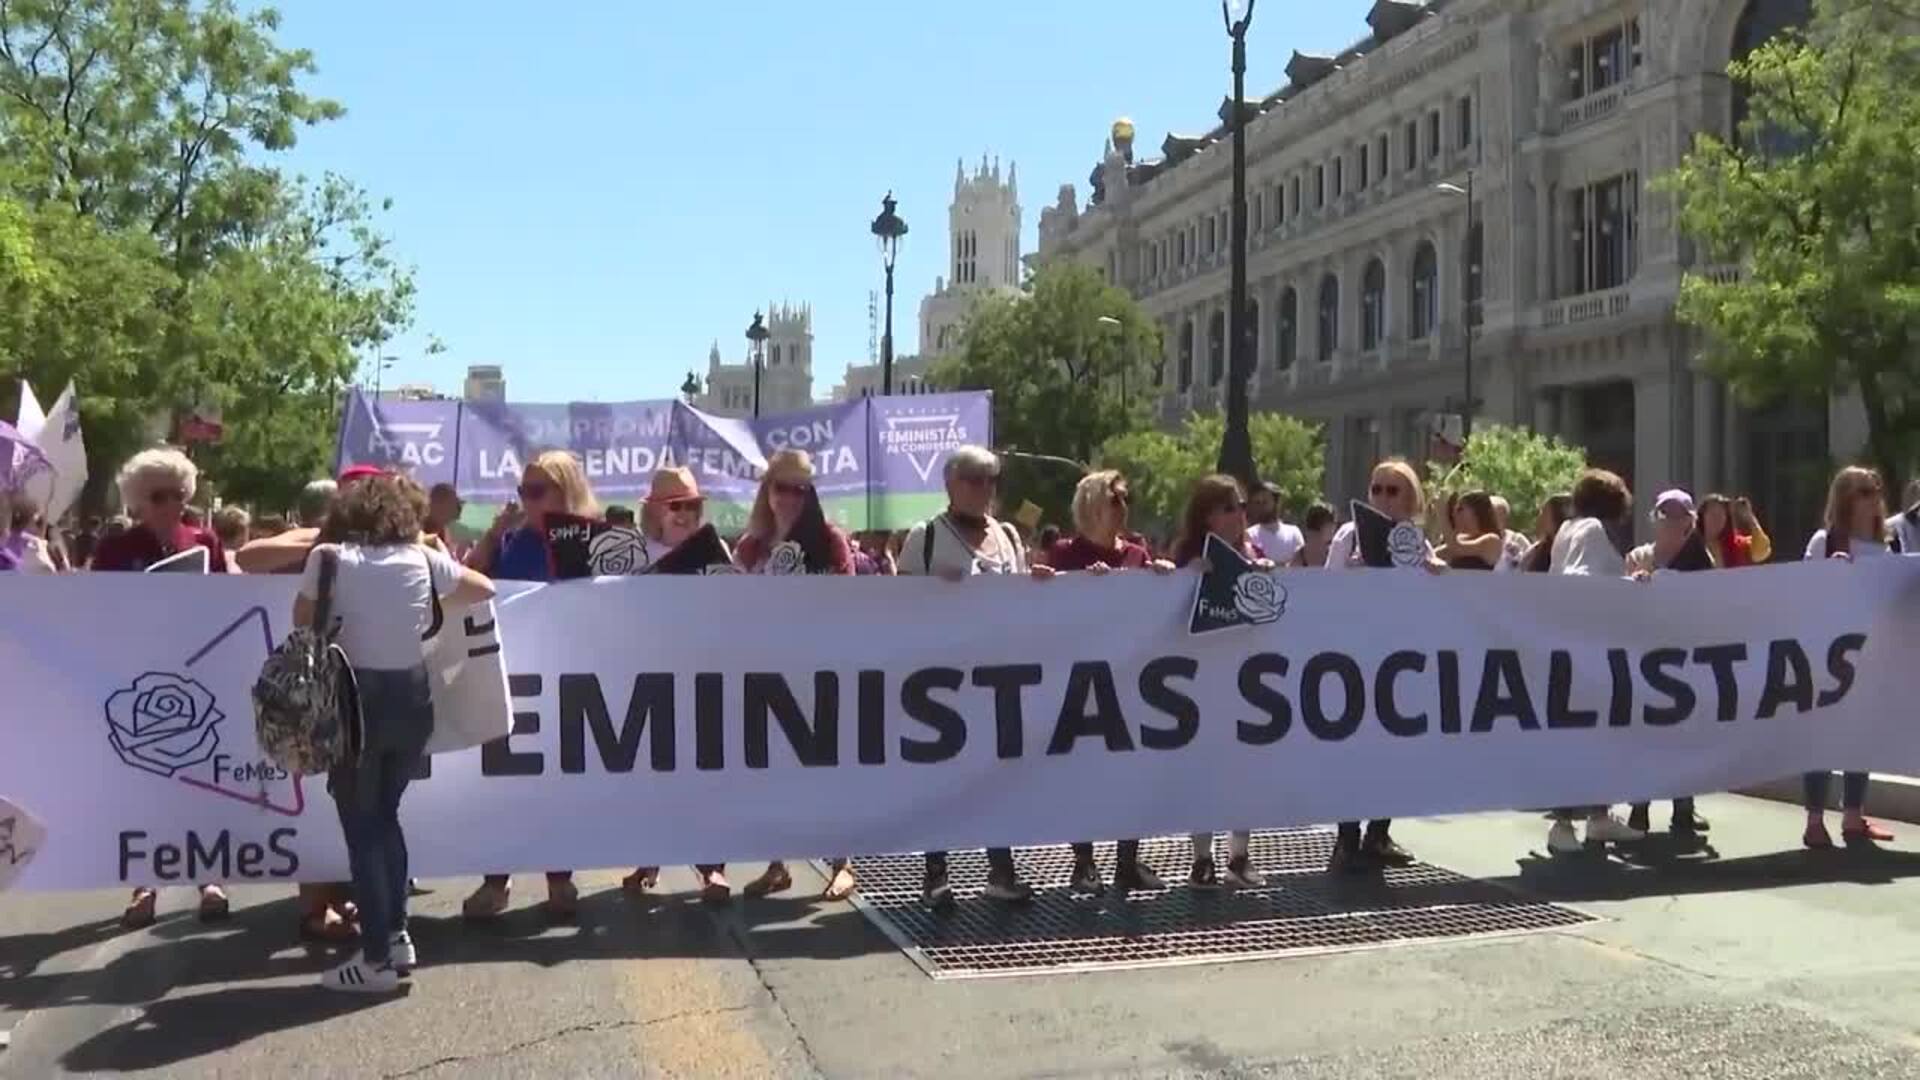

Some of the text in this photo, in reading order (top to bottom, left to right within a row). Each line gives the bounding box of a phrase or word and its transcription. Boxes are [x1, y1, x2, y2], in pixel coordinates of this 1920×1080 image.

[767, 419, 834, 446] CON
[879, 427, 967, 444] FEMINISTAS
[479, 447, 522, 480] LA
[418, 634, 1867, 779] EMINISTAS SOCIALISTAS
[213, 754, 288, 783] FeMeS
[118, 828, 299, 881] FeMeS
